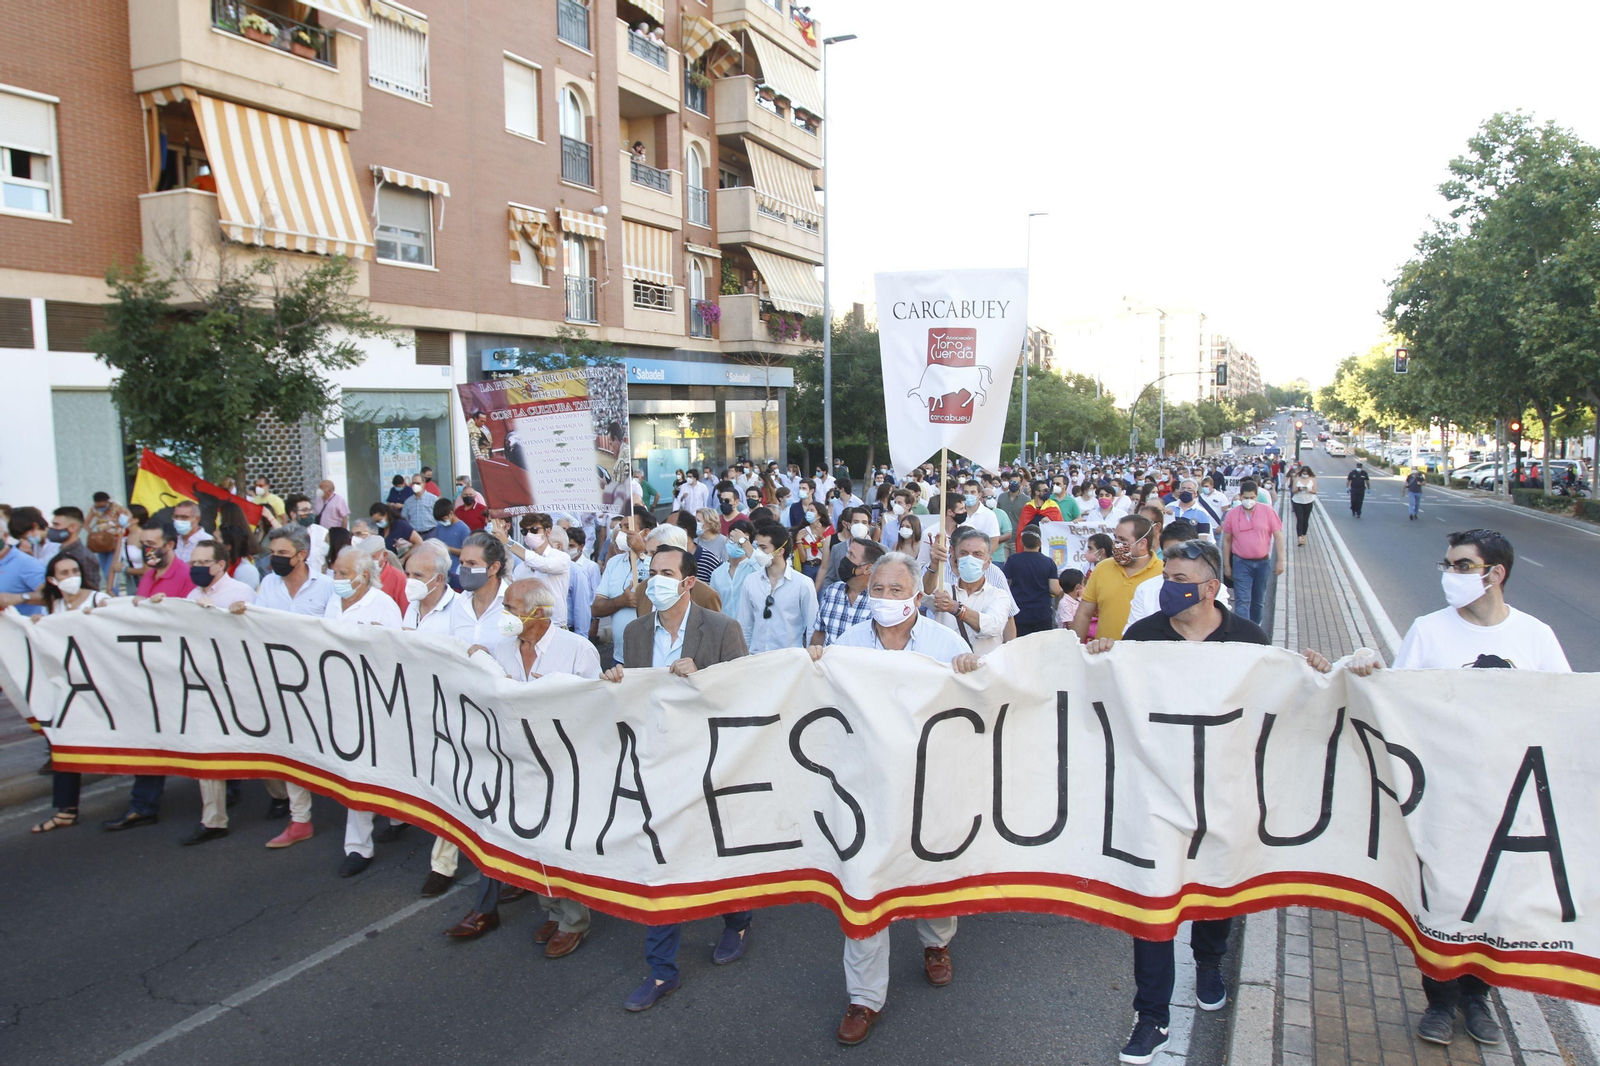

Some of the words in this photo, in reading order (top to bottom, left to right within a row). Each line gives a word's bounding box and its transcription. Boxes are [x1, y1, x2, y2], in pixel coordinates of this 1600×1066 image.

[892, 299, 1010, 321] CARCABUEY
[932, 333, 963, 350] Toro
[636, 368, 665, 381] Sabadell
[728, 372, 751, 383] Sabadell
[490, 409, 513, 421] CON
[512, 408, 527, 418] LA
[527, 402, 574, 416] CULTURA
[930, 413, 971, 423] carcabuey
[529, 503, 566, 514] NUESTRA
[567, 502, 590, 513] FIESTA
[1068, 524, 1096, 535] Peña
[25, 636, 117, 731] LA
[117, 635, 667, 866] TAUROMAQUIA
[703, 707, 868, 863] ES
[911, 690, 1578, 924] CULTURA
